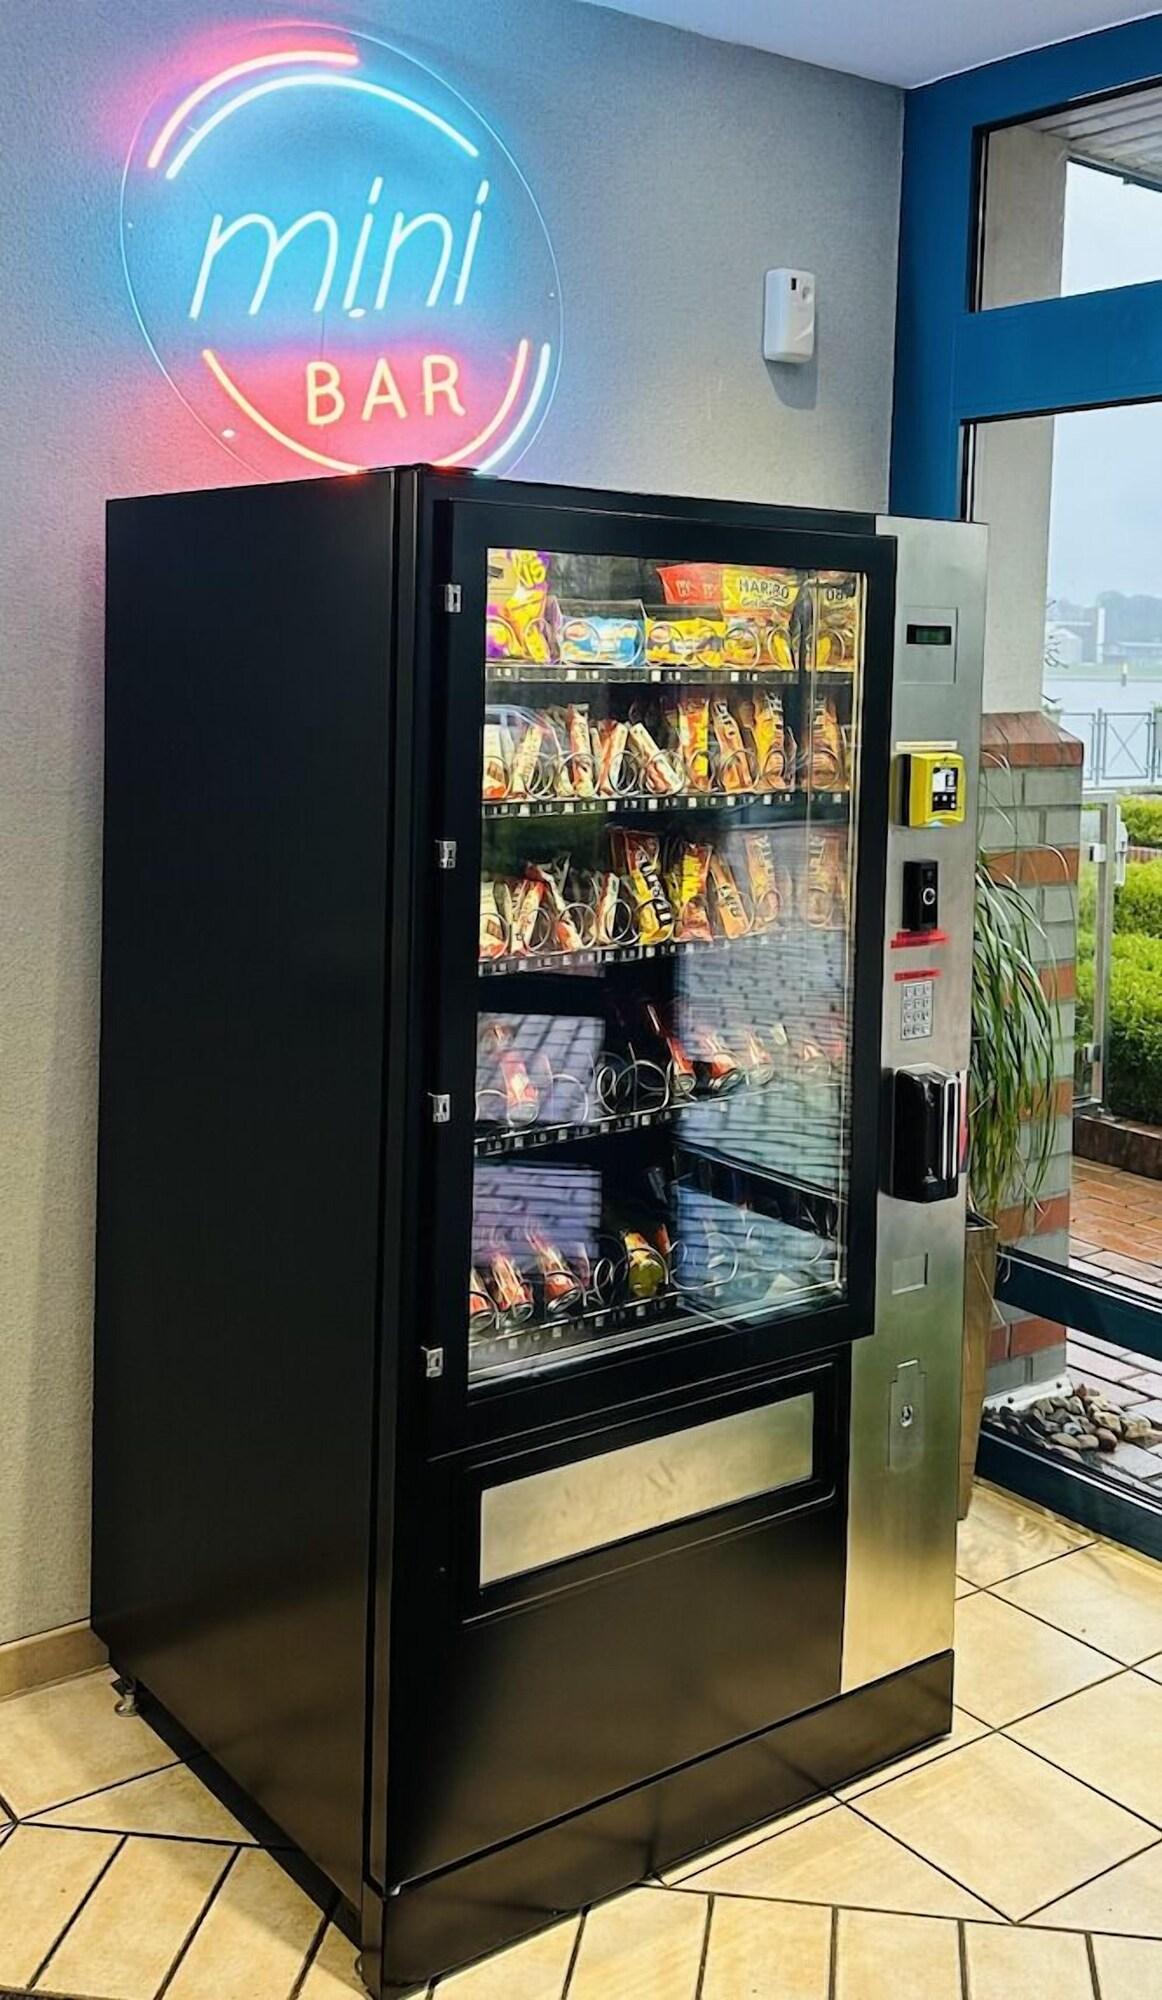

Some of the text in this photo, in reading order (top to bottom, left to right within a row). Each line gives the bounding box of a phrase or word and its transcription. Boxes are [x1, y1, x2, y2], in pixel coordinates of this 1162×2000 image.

[190, 176, 490, 320] mini
[305, 354, 466, 426] BAR
[739, 576, 790, 600] HARIBO
